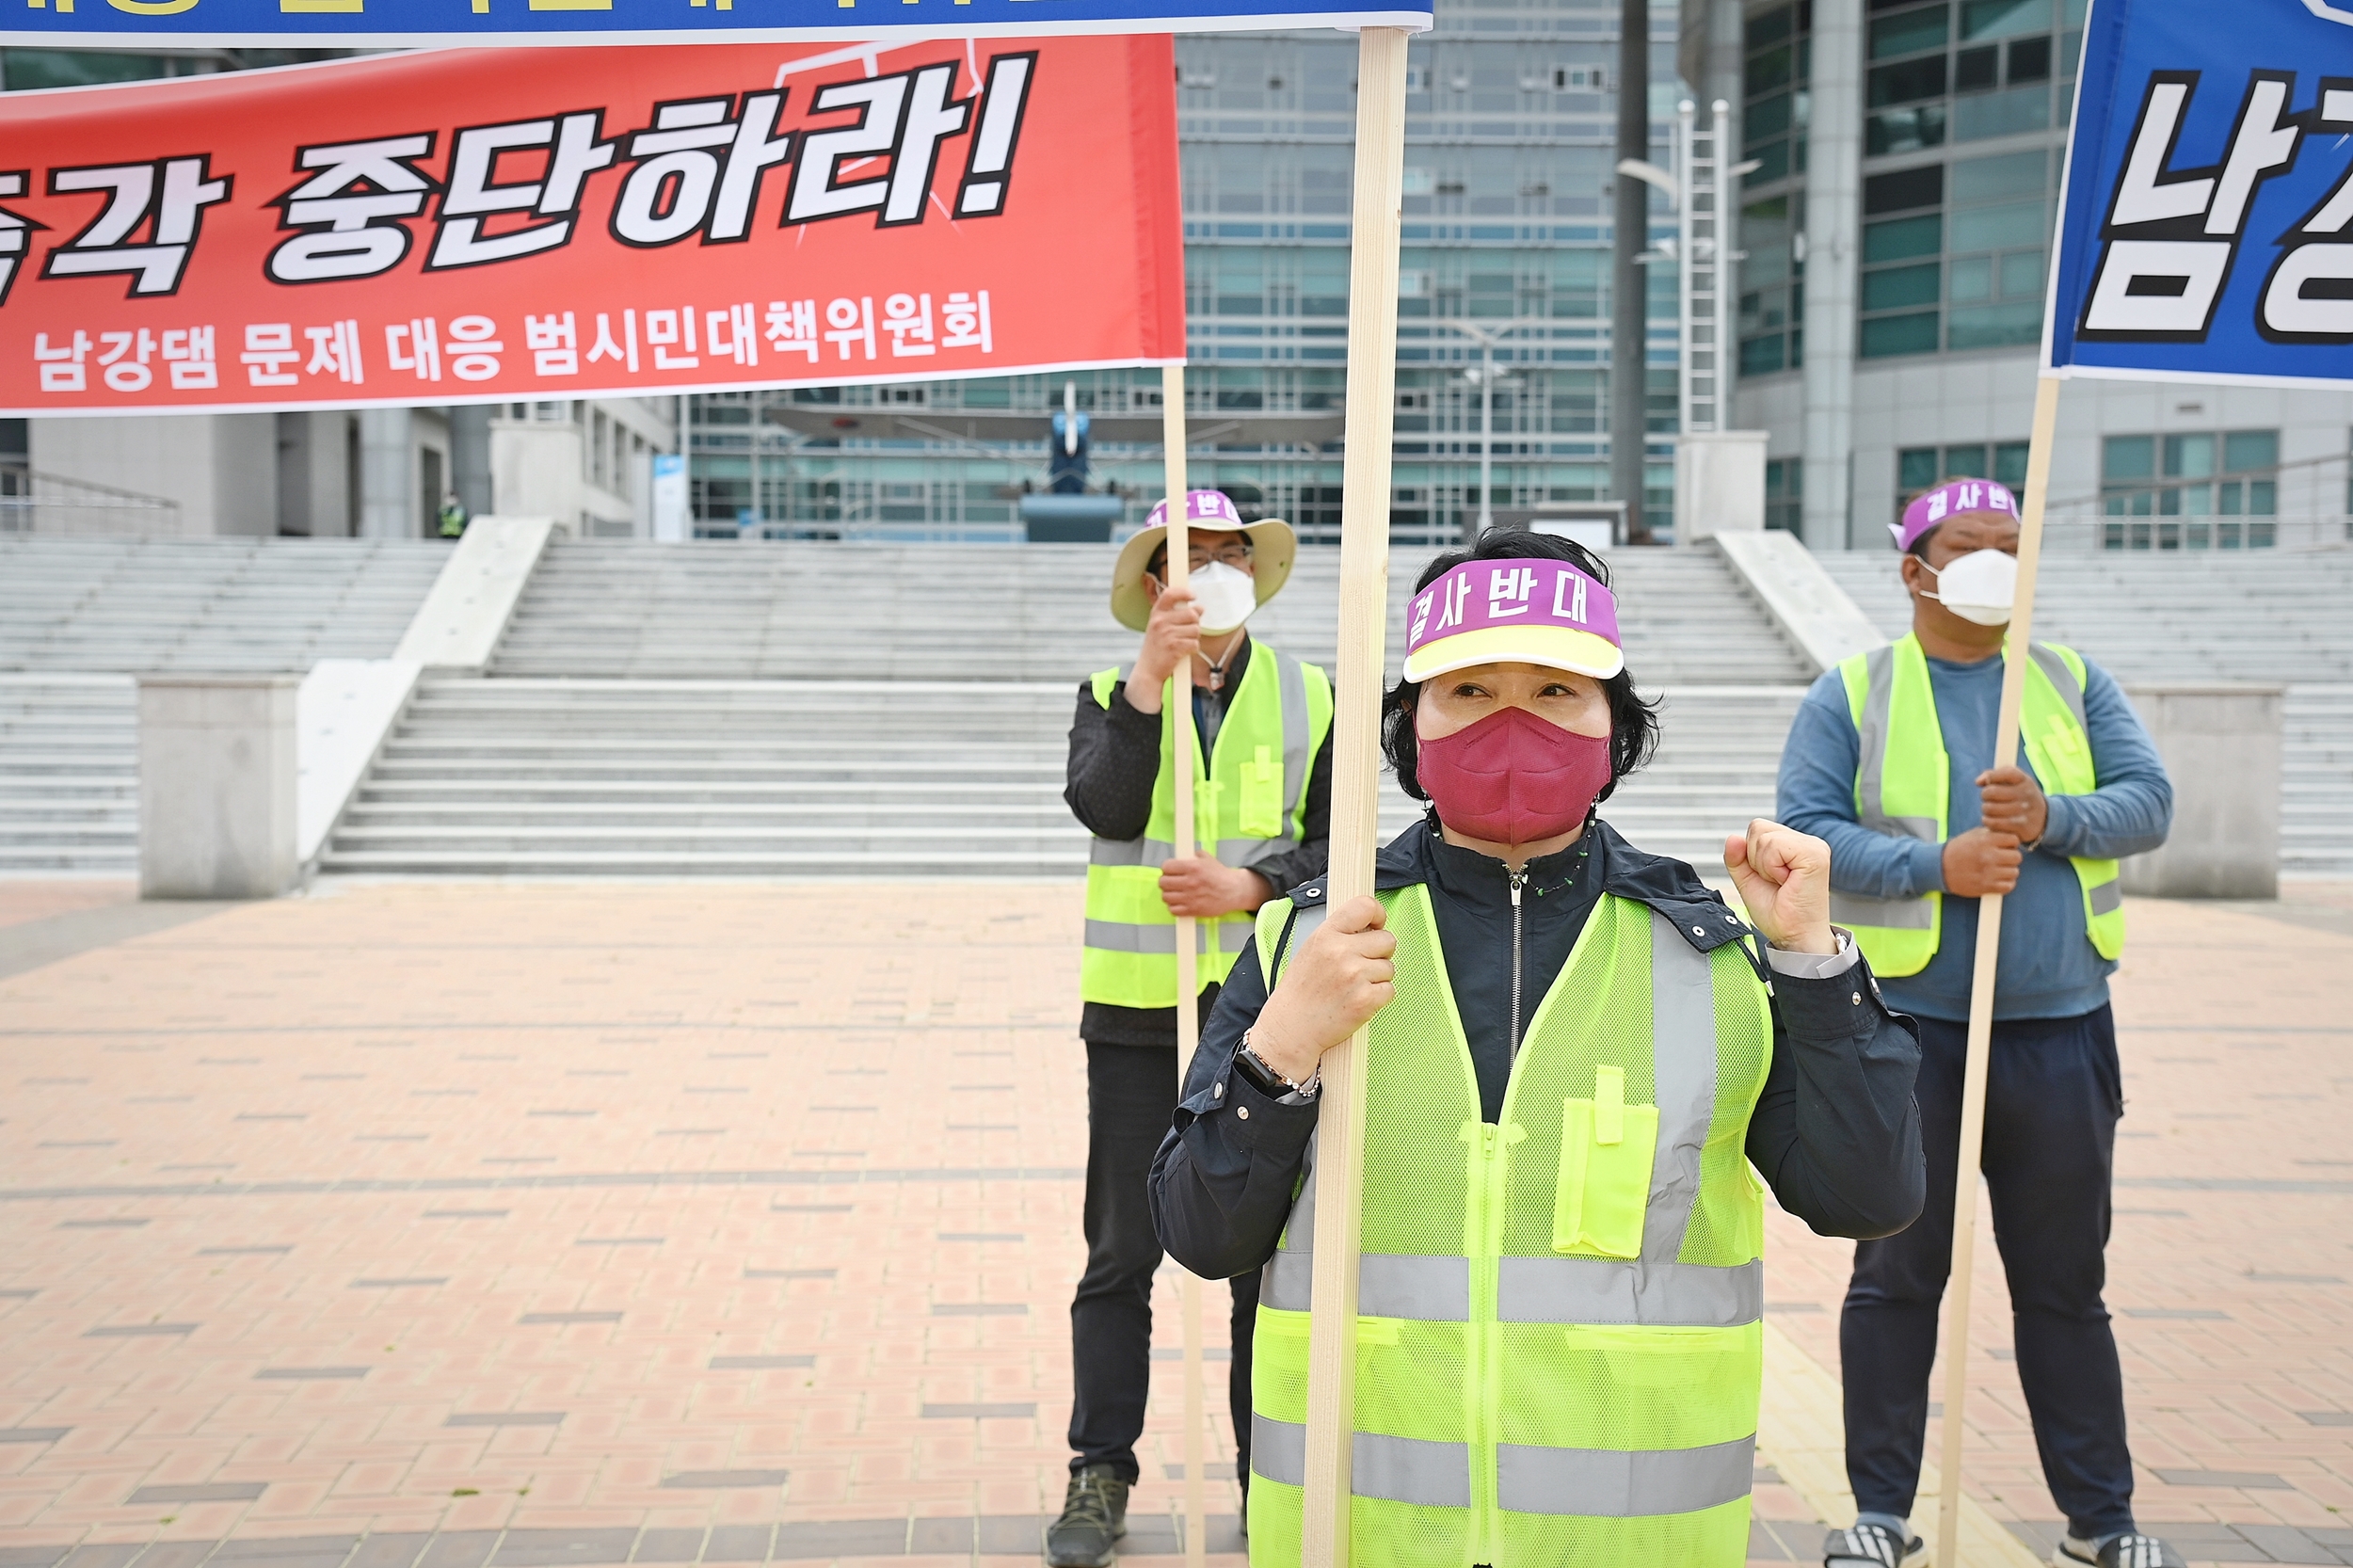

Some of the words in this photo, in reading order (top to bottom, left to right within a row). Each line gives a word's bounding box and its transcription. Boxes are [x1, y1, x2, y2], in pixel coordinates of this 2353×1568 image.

[263, 50, 1039, 285] 중단하라!
[34, 325, 218, 392] 남강댐
[240, 319, 364, 386] 문제
[385, 315, 504, 382] 대응
[525, 290, 993, 376] 범시민대책위원회
